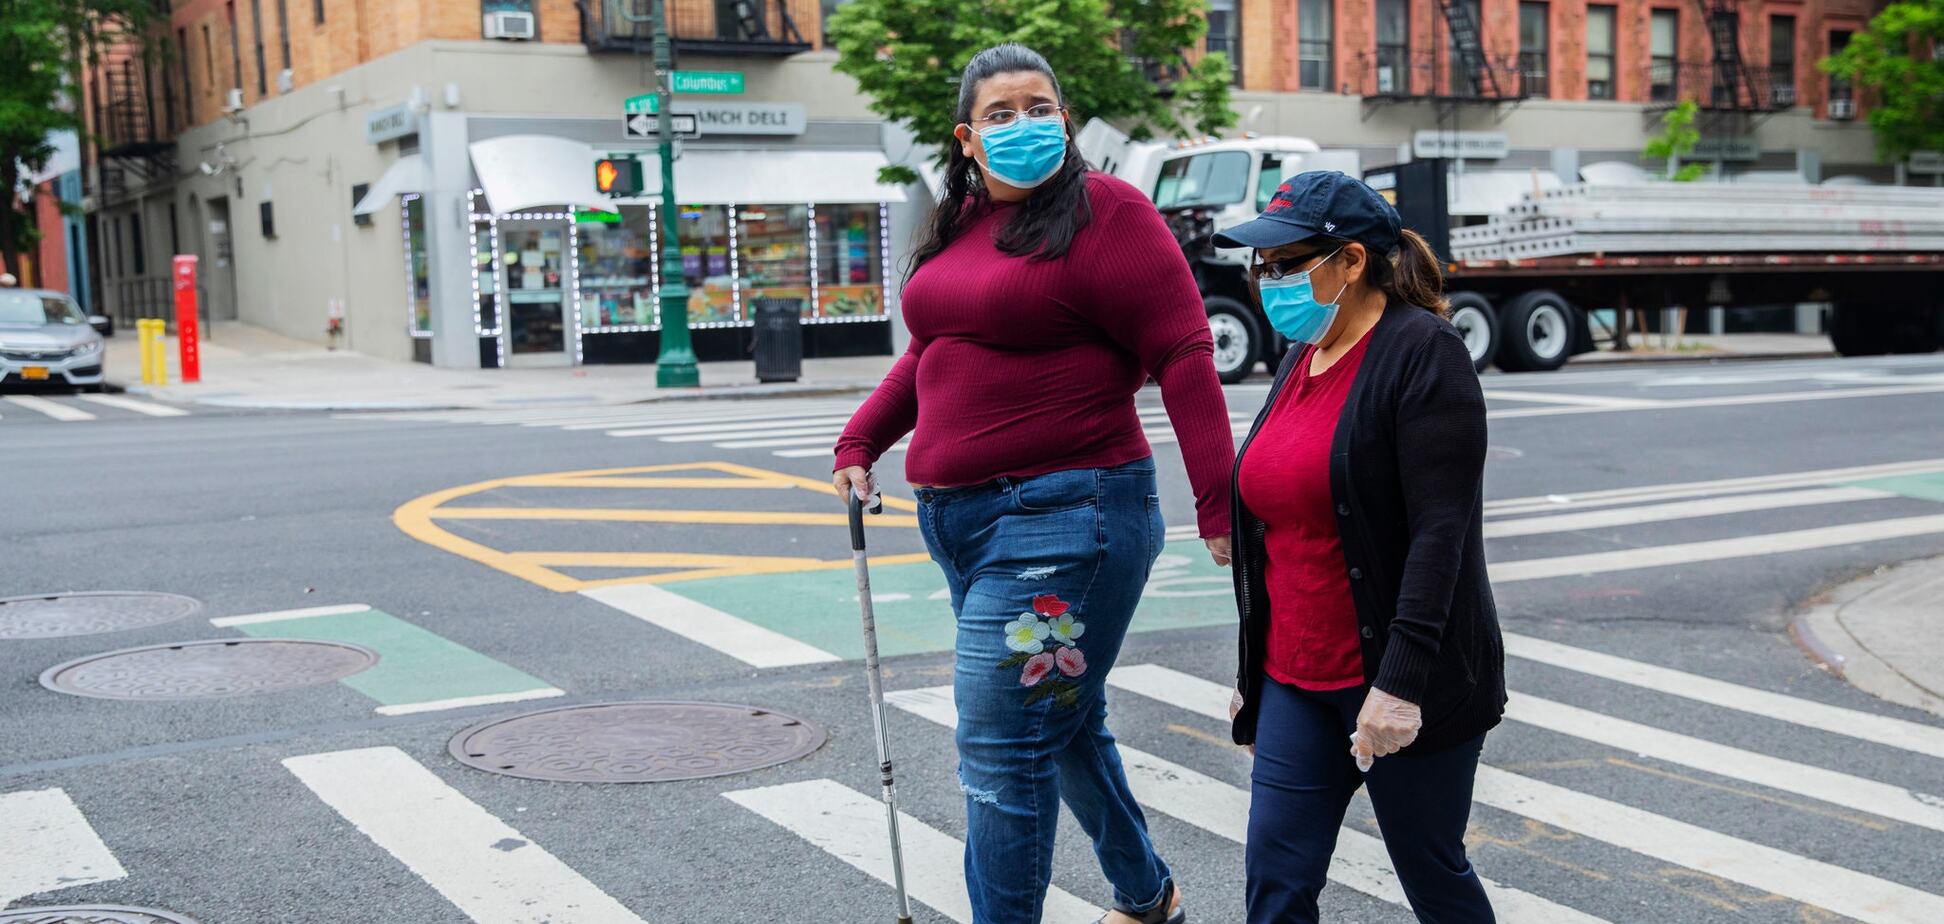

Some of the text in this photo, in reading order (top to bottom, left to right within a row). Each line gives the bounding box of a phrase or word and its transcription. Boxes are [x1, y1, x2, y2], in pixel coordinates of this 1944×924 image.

[677, 76, 727, 91] Columbus
[698, 111, 787, 126] ANCH DELI
